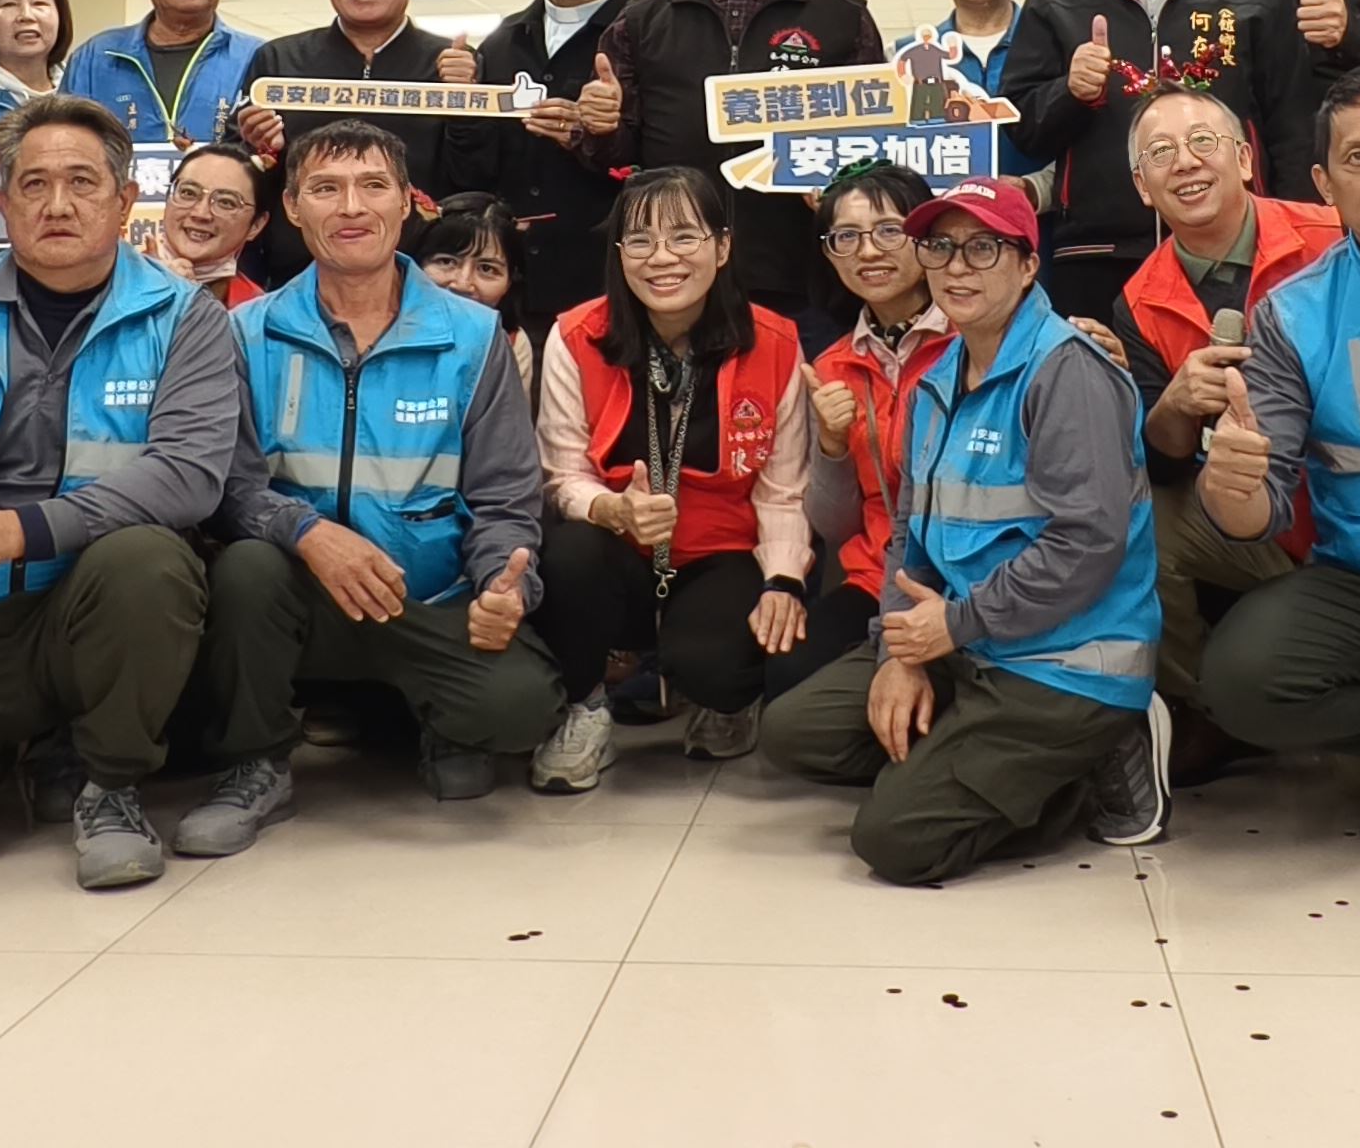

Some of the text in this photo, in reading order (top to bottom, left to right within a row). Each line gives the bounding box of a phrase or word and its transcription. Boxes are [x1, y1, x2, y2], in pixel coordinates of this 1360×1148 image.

[265, 83, 489, 110] 泰安鄉公所道路養護所
[721, 78, 894, 126] 養護到位
[788, 134, 972, 177] 安全加倍
